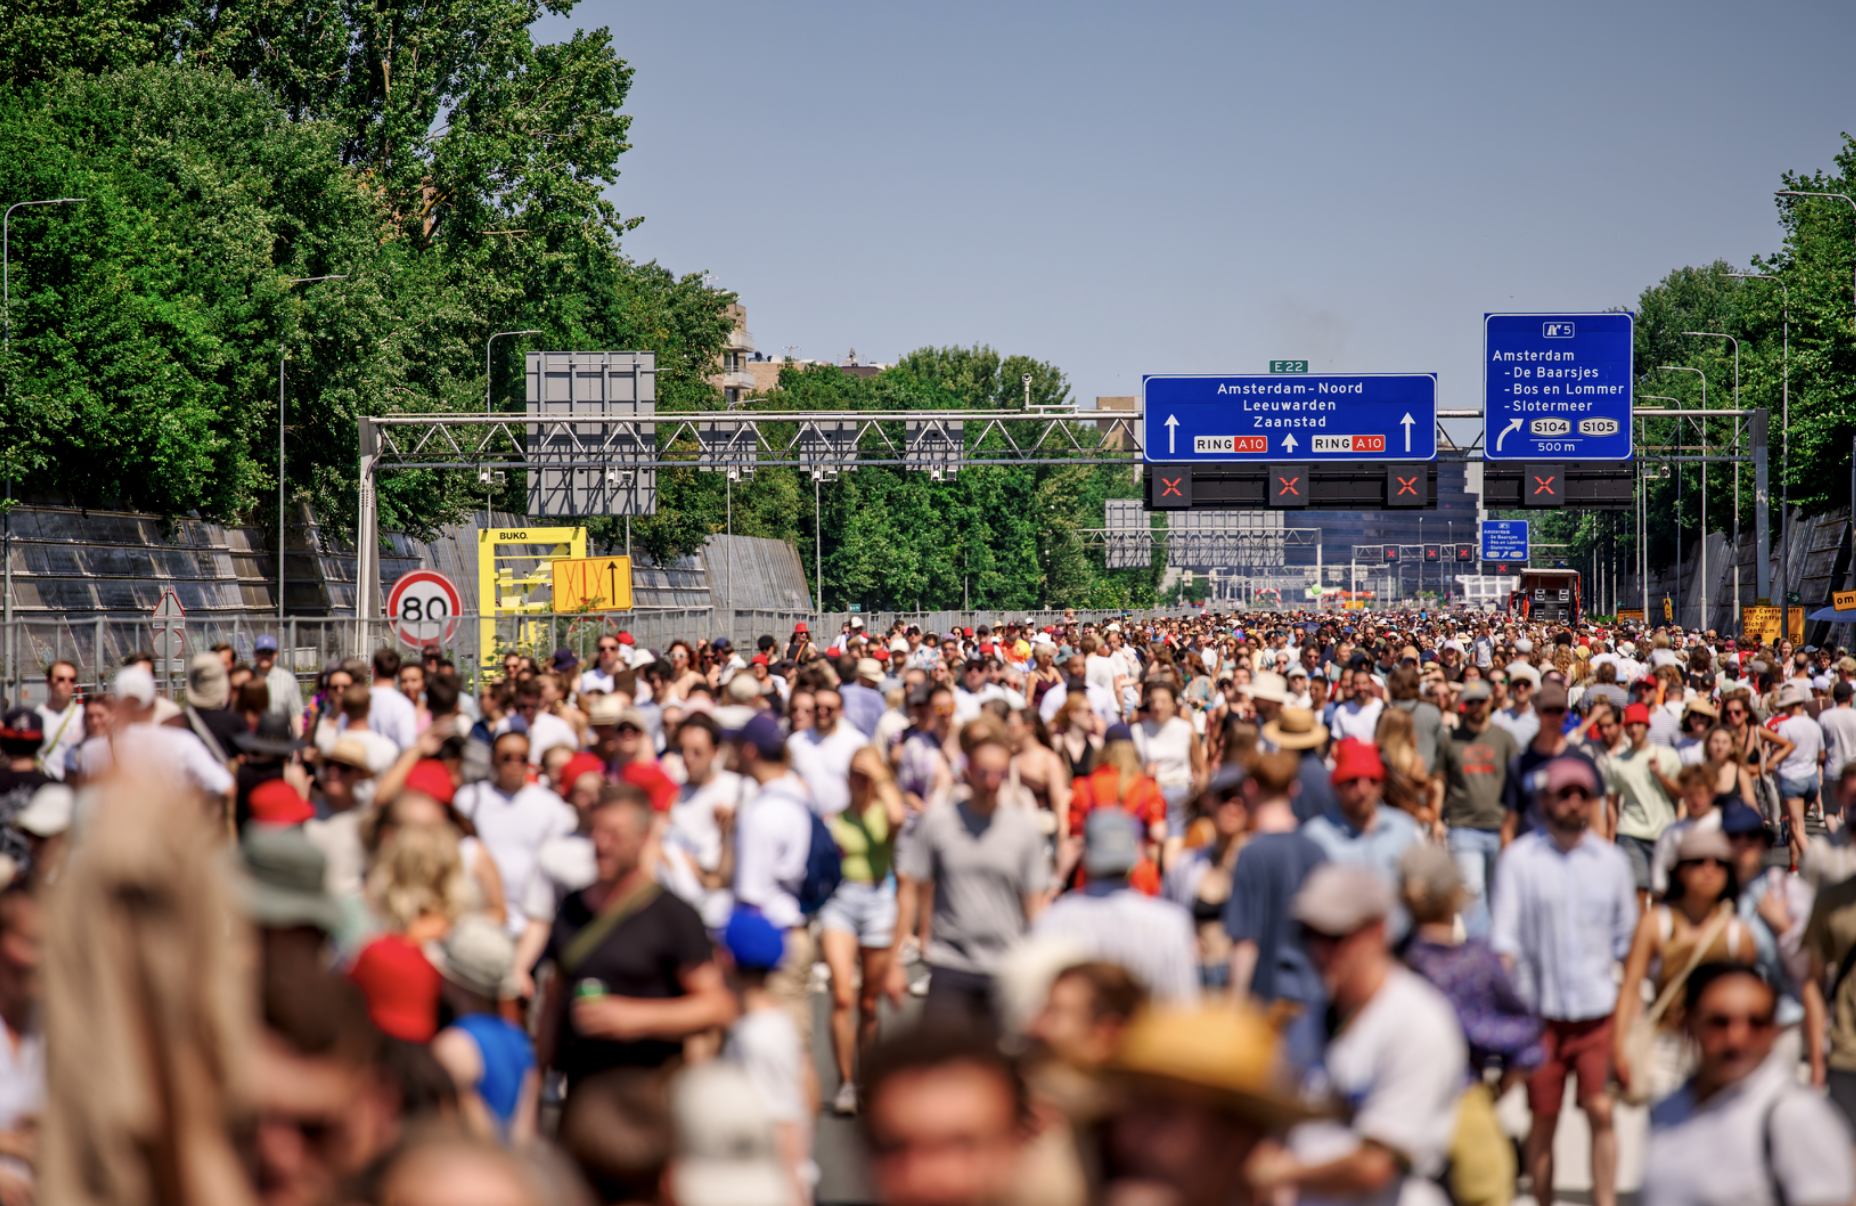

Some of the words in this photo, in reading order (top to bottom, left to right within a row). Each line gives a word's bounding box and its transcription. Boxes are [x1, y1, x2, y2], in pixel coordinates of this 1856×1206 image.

[1563, 325, 1571, 335] 5
[1492, 349, 1575, 362] Amsterdam
[1536, 366, 1599, 381] Baarsjes
[1217, 382, 1363, 395] Amsterdam-Noord
[1543, 386, 1560, 395] en
[1566, 383, 1624, 395] Lommer
[1243, 399, 1336, 411] Leeuwarden
[1253, 415, 1326, 428] Zaanstad
[1534, 422, 1567, 432] S104
[1582, 422, 1615, 432] S105
[1197, 439, 1233, 450] RING
[1238, 438, 1264, 449] A10
[1315, 438, 1350, 449] RING
[1356, 438, 1382, 449] A10
[1537, 442, 1562, 452] 500
[1564, 444, 1575, 452] m
[402, 596, 448, 622] 80
